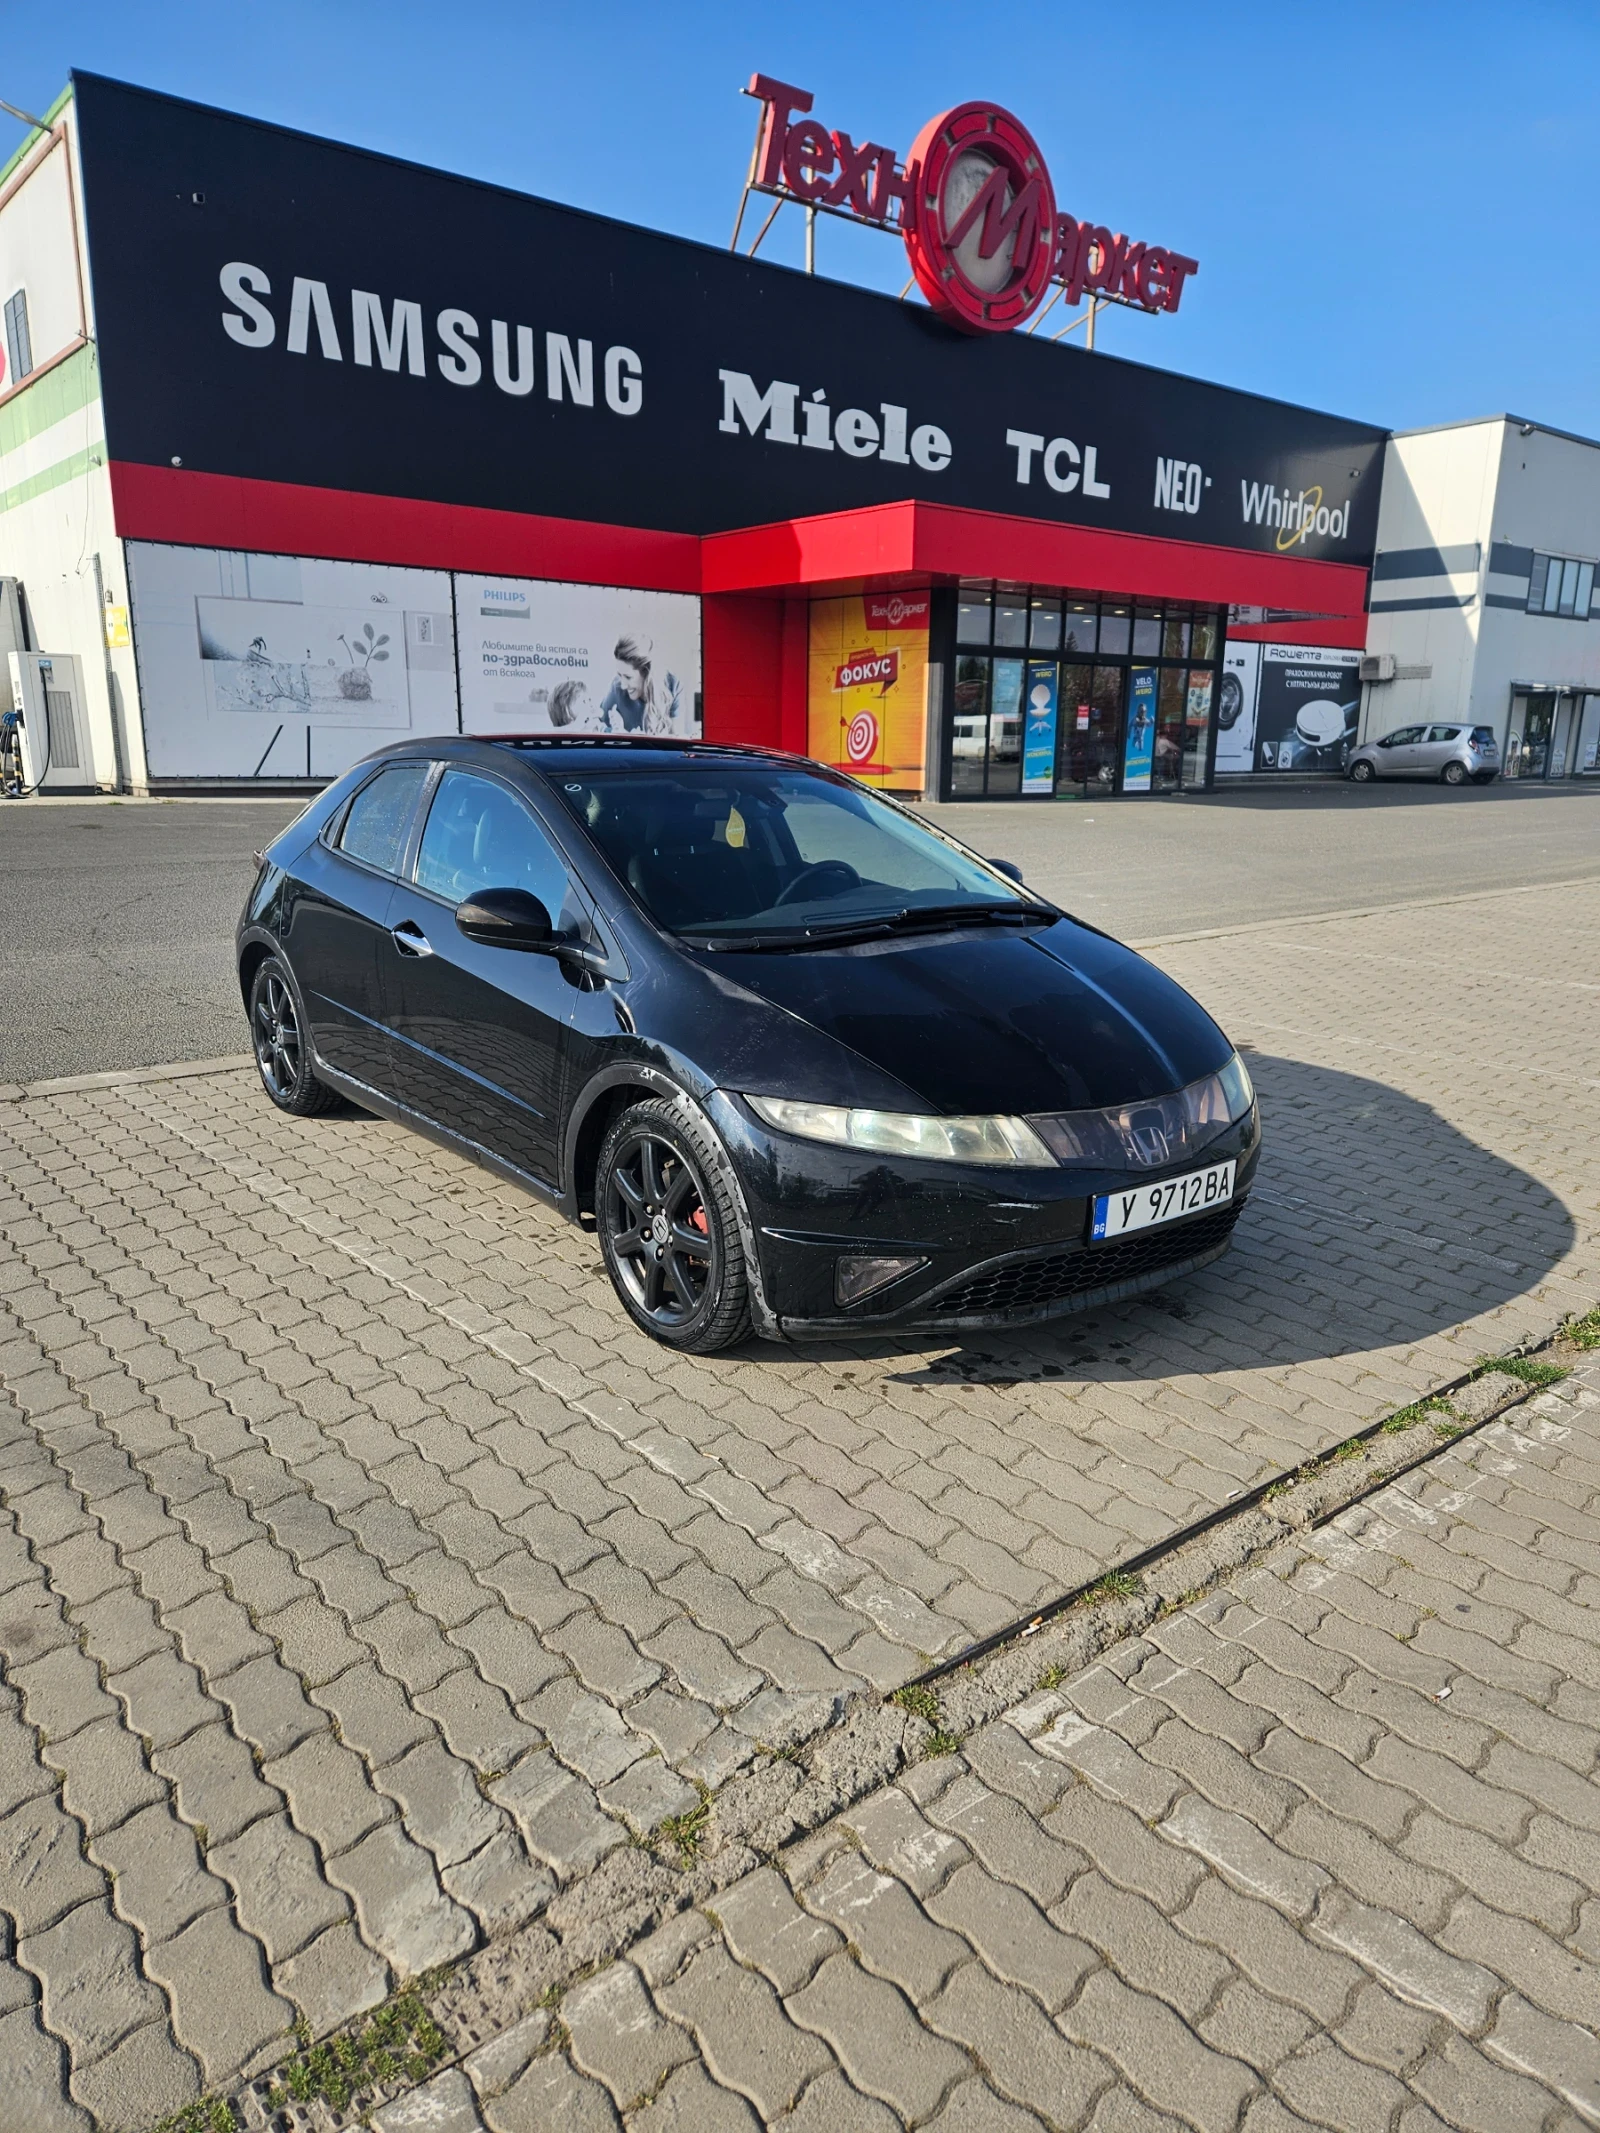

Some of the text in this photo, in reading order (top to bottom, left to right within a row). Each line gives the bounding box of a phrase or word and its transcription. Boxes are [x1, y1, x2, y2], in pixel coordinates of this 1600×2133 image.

[219, 261, 643, 416] SAMSUNG
[718, 368, 952, 472] Miele
[1006, 428, 1110, 499] TCL
[1154, 455, 1202, 515] NEO
[1241, 478, 1350, 548] Whirlpool
[483, 589, 526, 602] PHILIPS
[482, 640, 588, 655] Любимите ви ястия са
[482, 653, 589, 668] по-здравословни
[483, 668, 536, 678] от всякога
[840, 658, 891, 685] ФОКУС
[1135, 676, 1152, 686] VELO
[1094, 1223, 1105, 1235] BG
